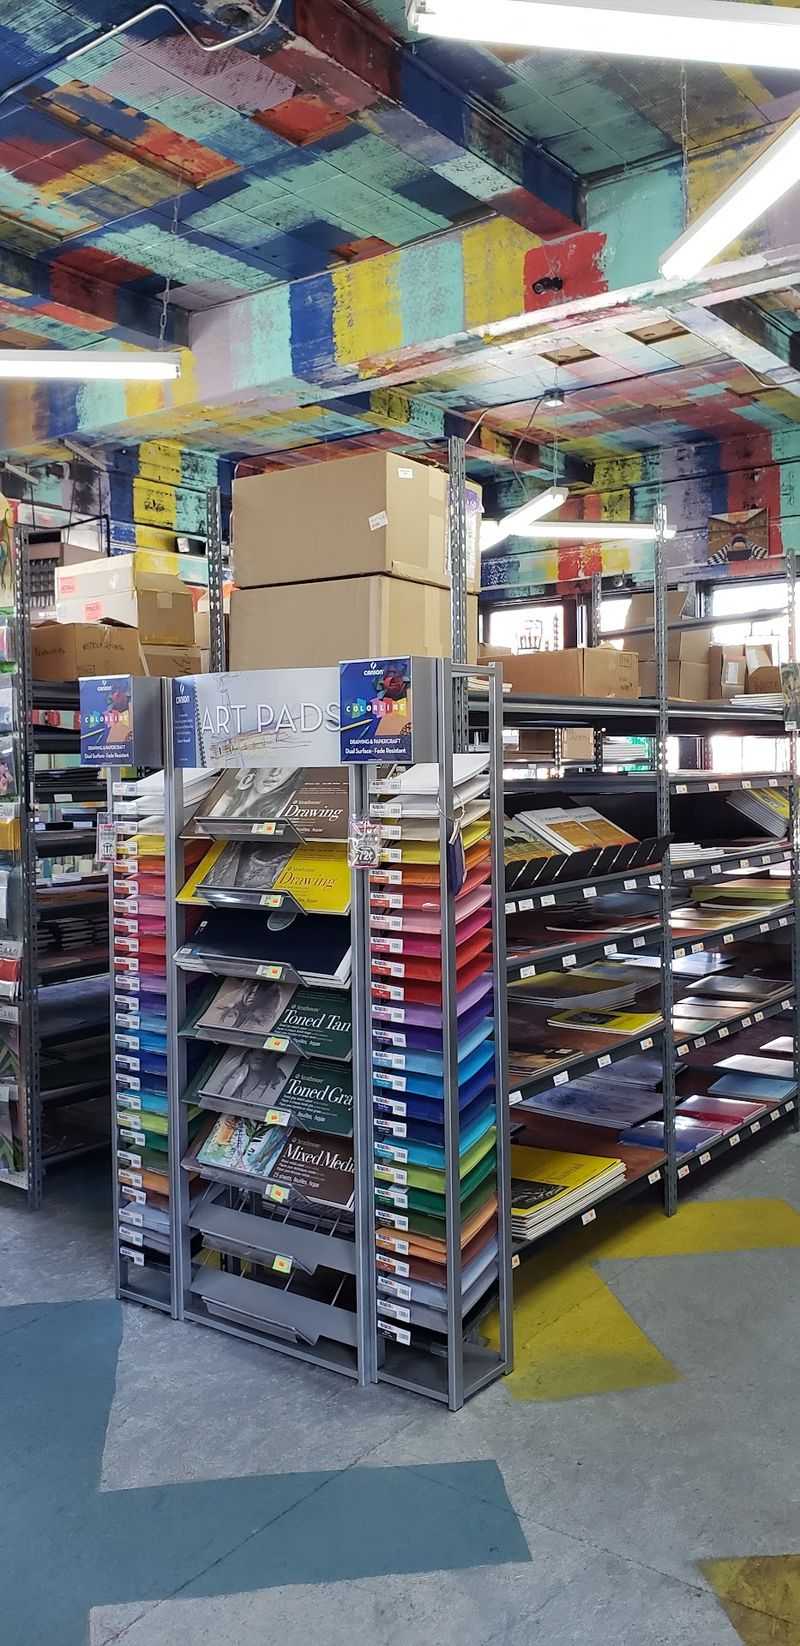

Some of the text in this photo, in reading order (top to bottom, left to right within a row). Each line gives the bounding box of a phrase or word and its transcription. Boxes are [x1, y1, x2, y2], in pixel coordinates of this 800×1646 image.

[200, 704, 247, 734] ART
[256, 702, 341, 733] PADS
[346, 703, 406, 713] COLORLINE
[284, 804, 343, 822] Drawing
[279, 871, 335, 888] Drawing
[283, 1008, 352, 1032] Toned Tan
[287, 1078, 331, 1101] Toned
[283, 1143, 326, 1166] Mixed
